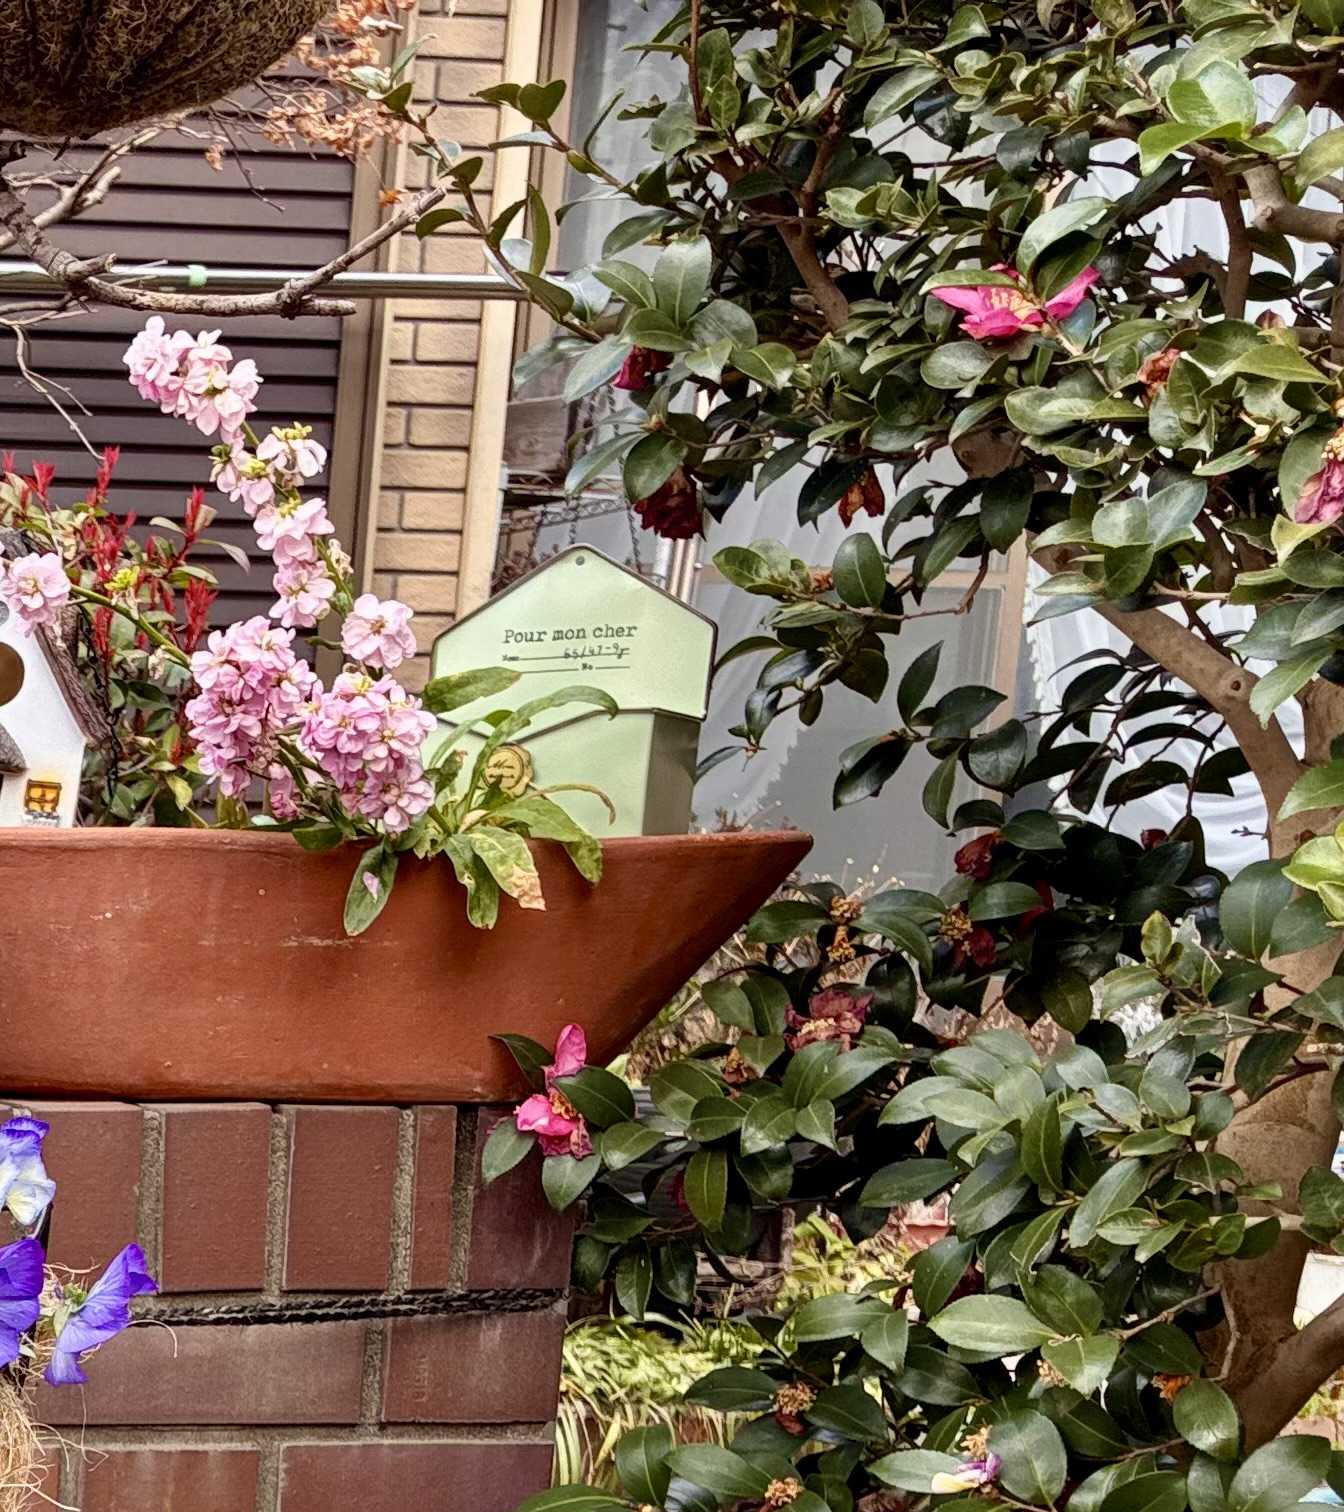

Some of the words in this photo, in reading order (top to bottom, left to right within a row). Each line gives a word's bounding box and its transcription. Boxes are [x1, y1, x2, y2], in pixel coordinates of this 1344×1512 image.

[503, 628, 548, 645] Pour
[552, 625, 587, 642] mon
[592, 623, 638, 640] cher
